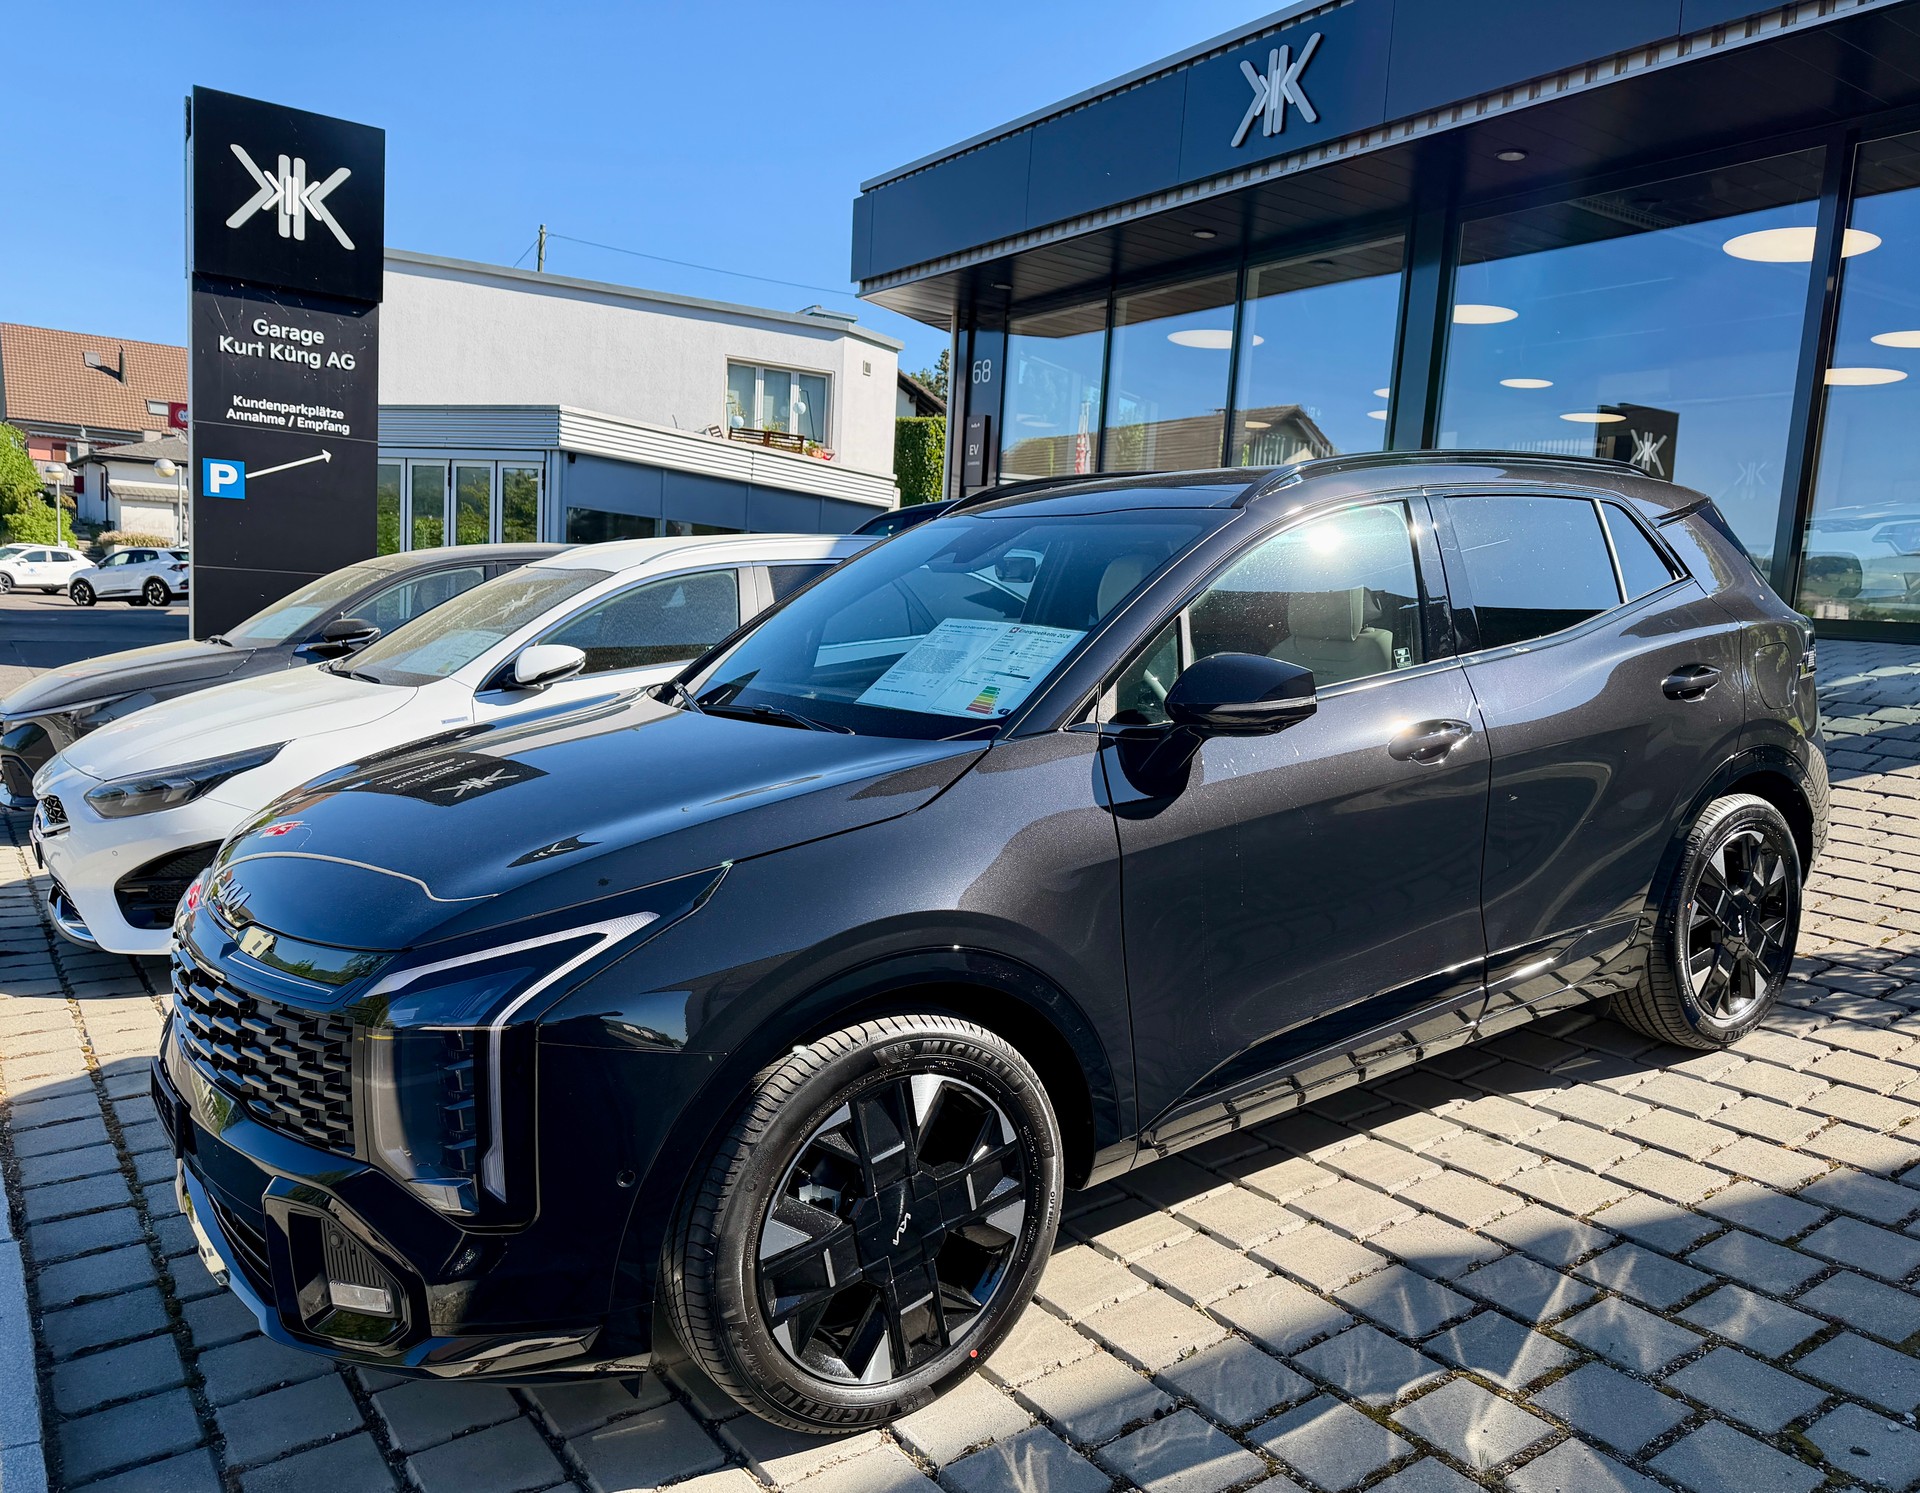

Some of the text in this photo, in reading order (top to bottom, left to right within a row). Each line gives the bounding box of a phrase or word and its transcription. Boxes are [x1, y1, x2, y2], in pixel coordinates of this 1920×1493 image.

[253, 318, 325, 346] Garage
[219, 335, 356, 370] Kurt Küng AG
[973, 359, 992, 384] 68
[226, 408, 350, 435] Annahme / Empfang
[233, 395, 345, 419] Kundenparkplätze
[969, 444, 979, 456] EV
[210, 463, 238, 493] P
[920, 1040, 1024, 1092] MICHELIN
[1046, 1191, 1056, 1230] OUTSIDE
[772, 1385, 894, 1422] MICHELIN
